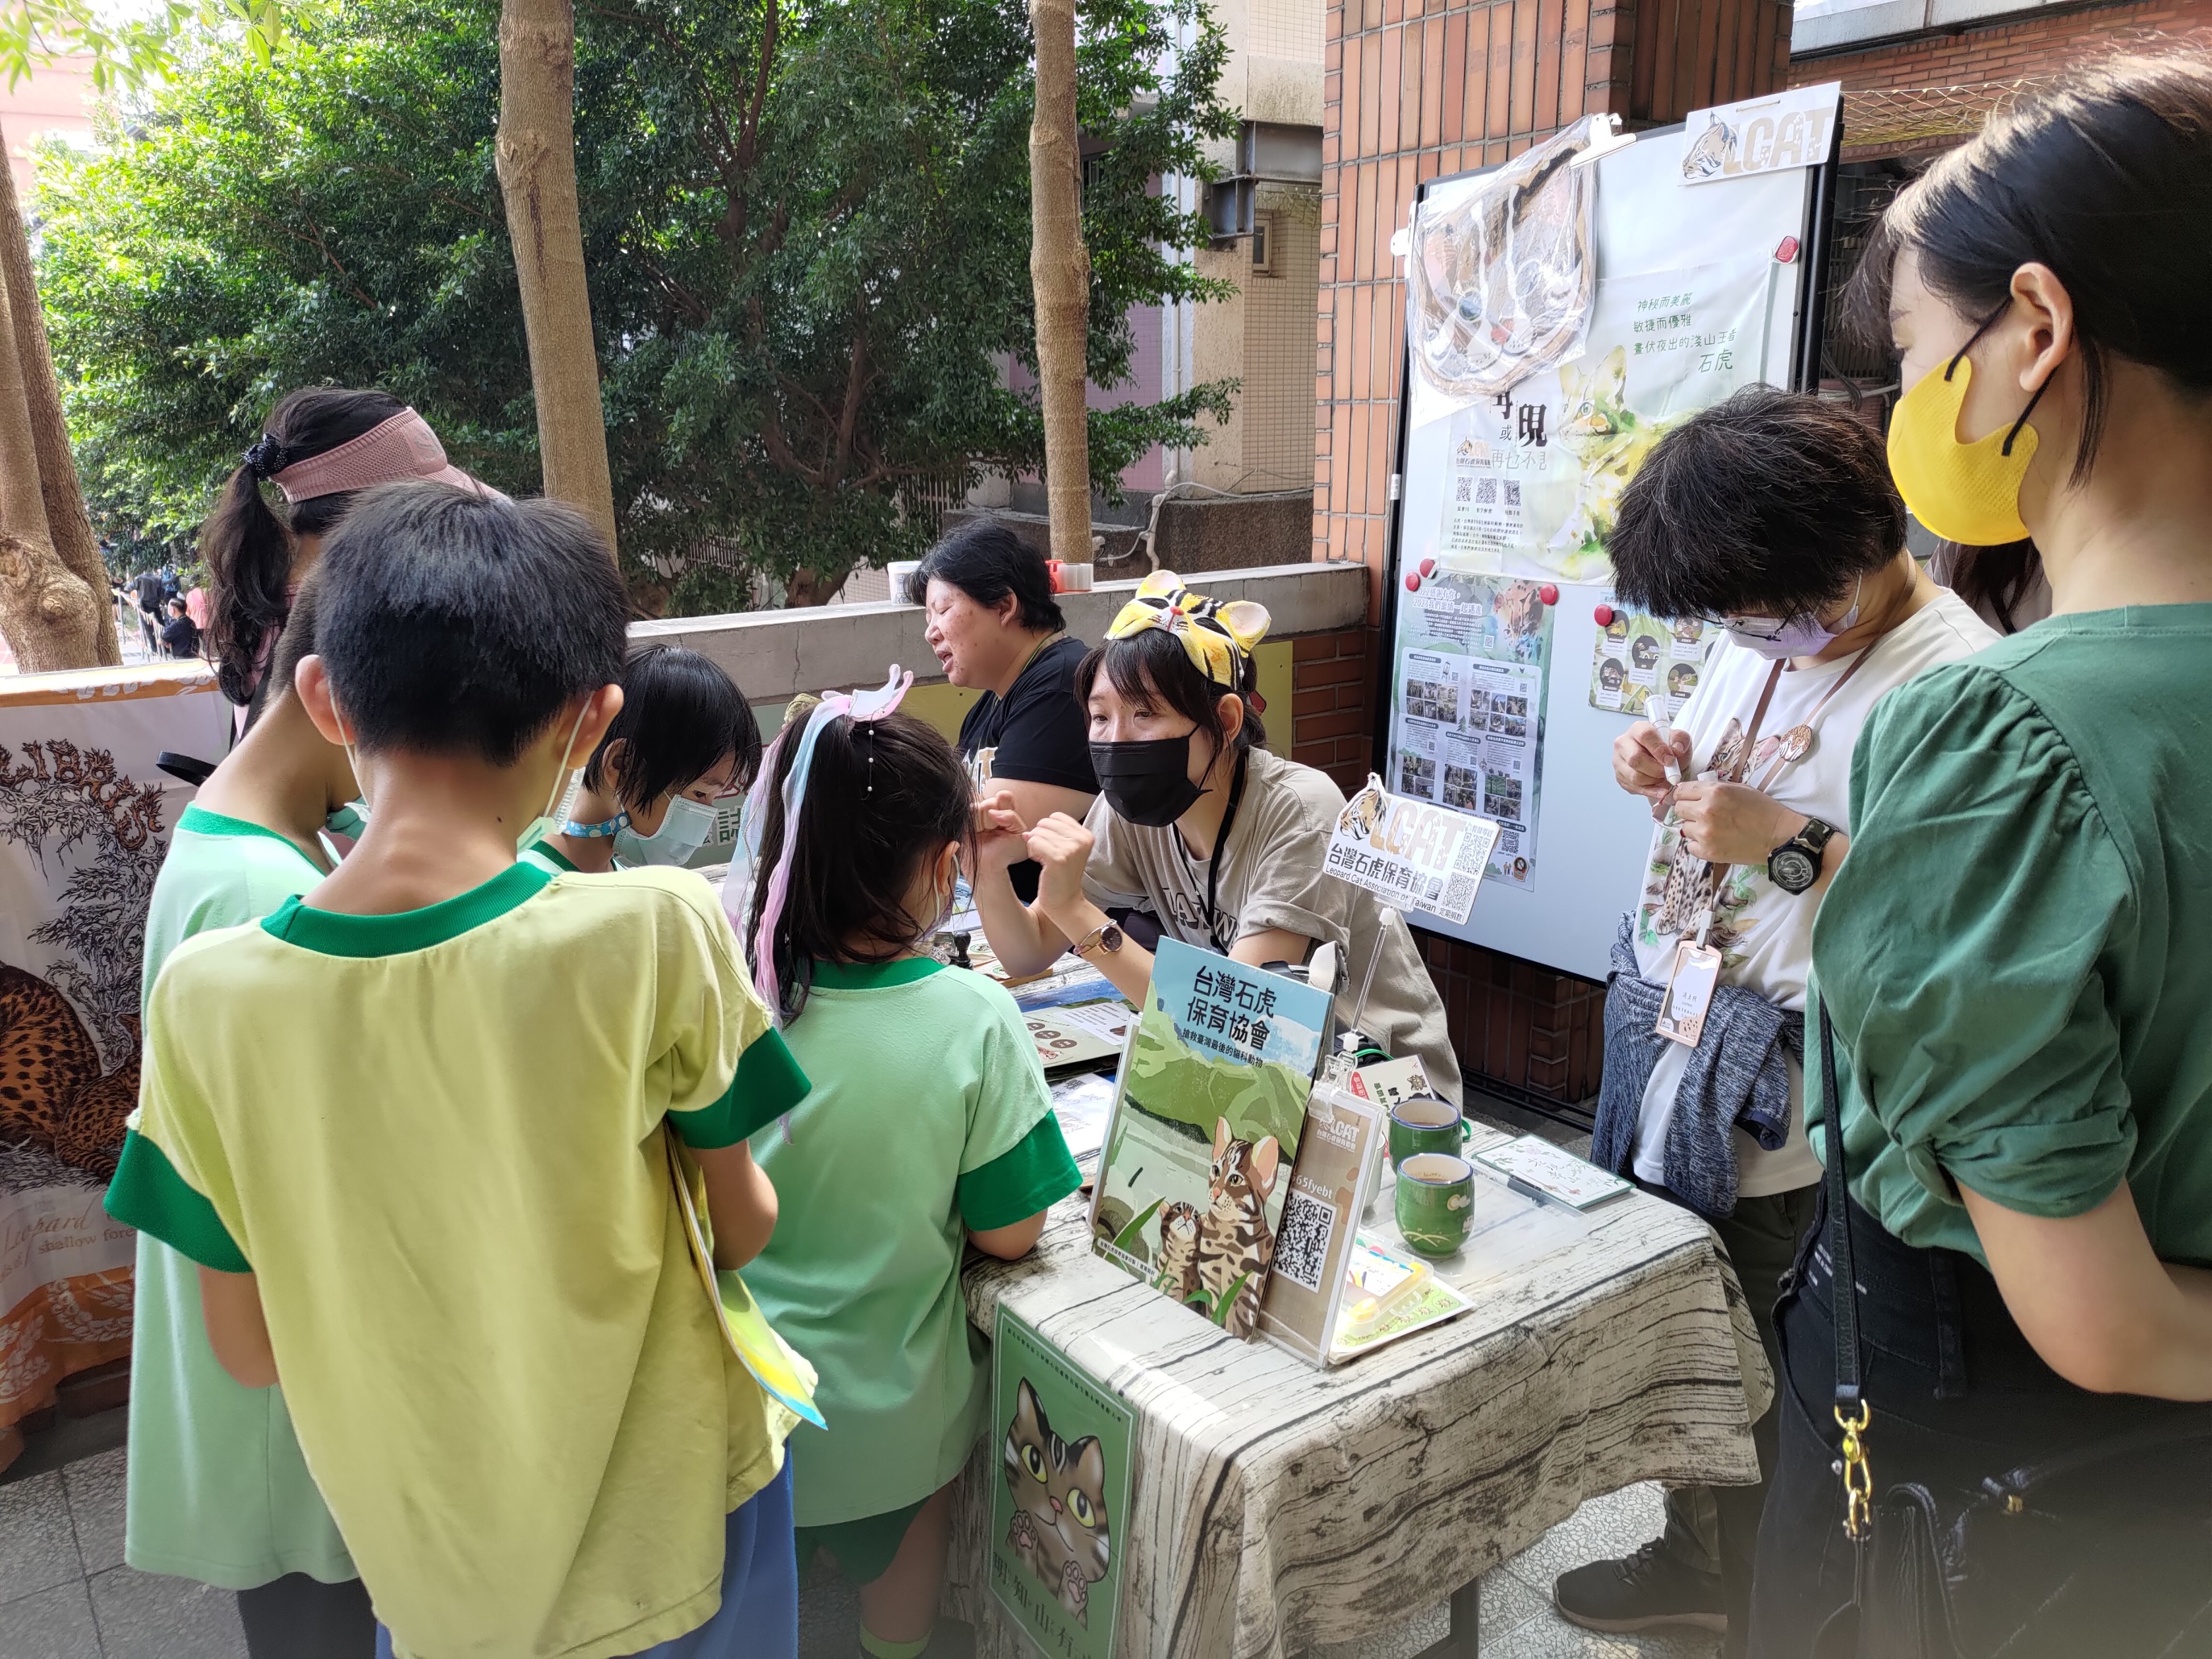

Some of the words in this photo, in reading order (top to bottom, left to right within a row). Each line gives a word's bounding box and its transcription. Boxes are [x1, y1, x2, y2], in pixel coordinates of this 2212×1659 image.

[1723, 106, 1836, 175] LCAT
[1633, 313, 1691, 334] 敏捷而優雅
[1637, 292, 1693, 313] 神秘而美麗
[1698, 347, 1733, 373] 石虎
[1370, 796, 1467, 872] LCAT
[1326, 865, 1351, 881] Leopard
[1351, 874, 1363, 885] Cat
[1411, 896, 1437, 913] Taiwan
[1328, 843, 1443, 902] 台灣石虎保育協會
[1193, 965, 1276, 1019] 台灣石虎
[1187, 996, 1270, 1051] 保育協會
[1182, 1027, 1264, 1068] 搶救臺灣最後的貓科動物
[1330, 1121, 1360, 1143] LCAT
[39, 1234, 97, 1255] shallow
